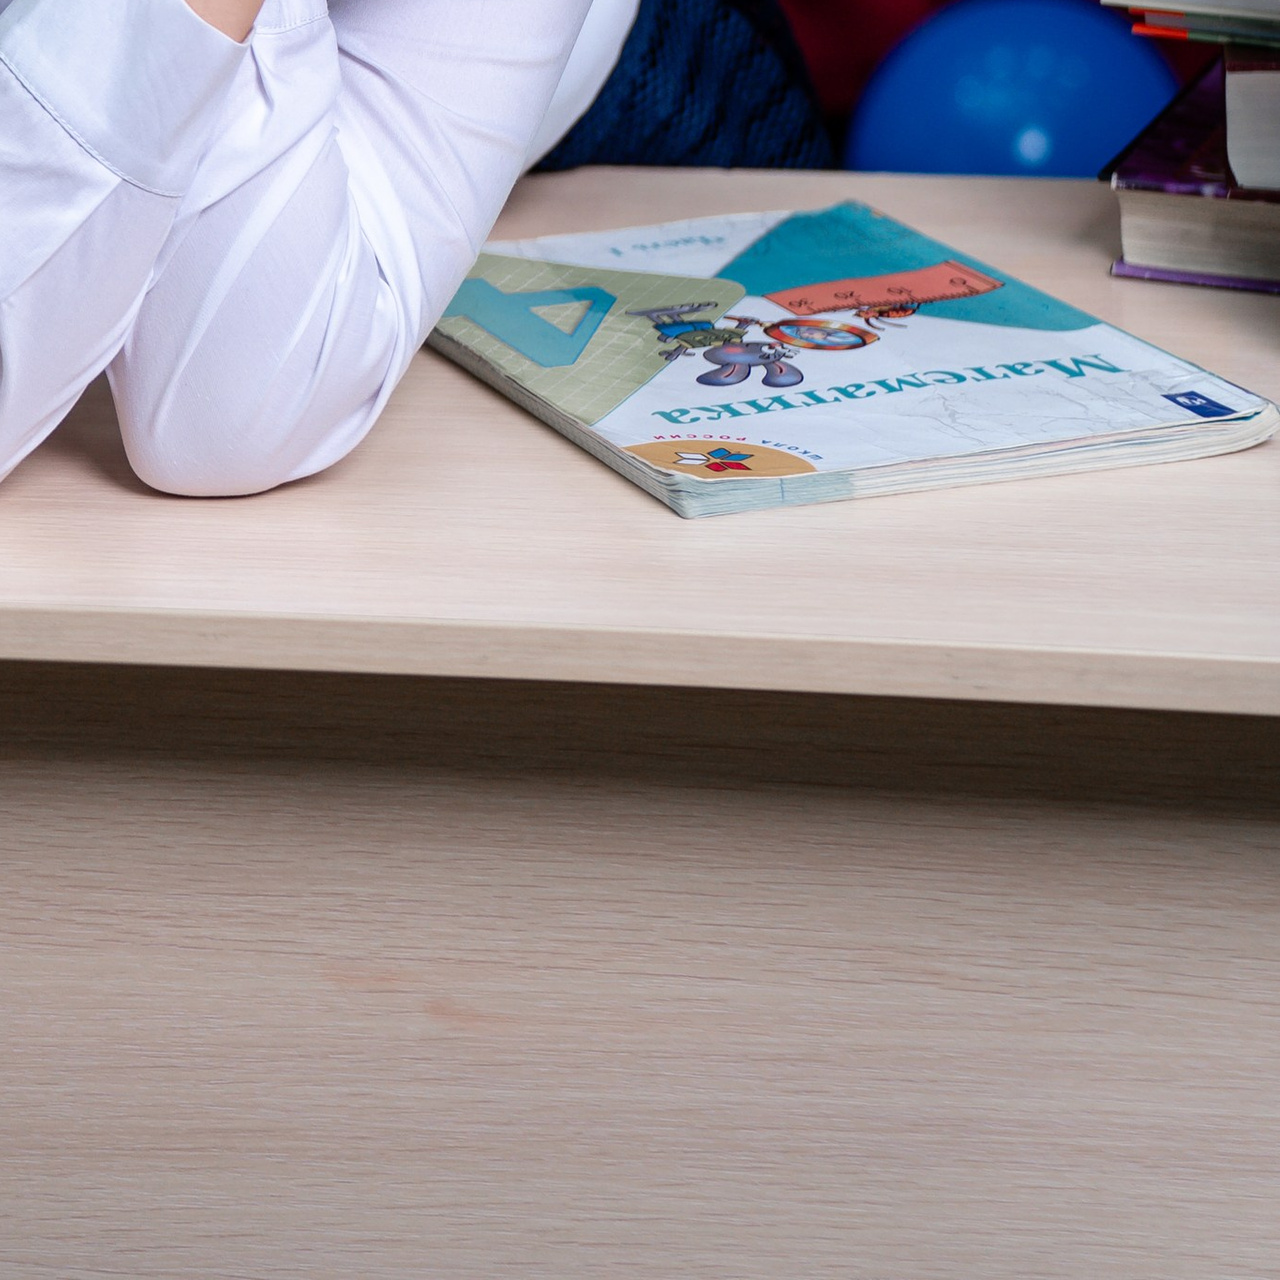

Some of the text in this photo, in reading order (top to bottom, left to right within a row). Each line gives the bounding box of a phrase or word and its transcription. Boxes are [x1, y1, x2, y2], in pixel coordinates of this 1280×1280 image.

[651, 354, 1132, 425] Математика
[653, 433, 824, 460] ШКОЛА РОССИИ
